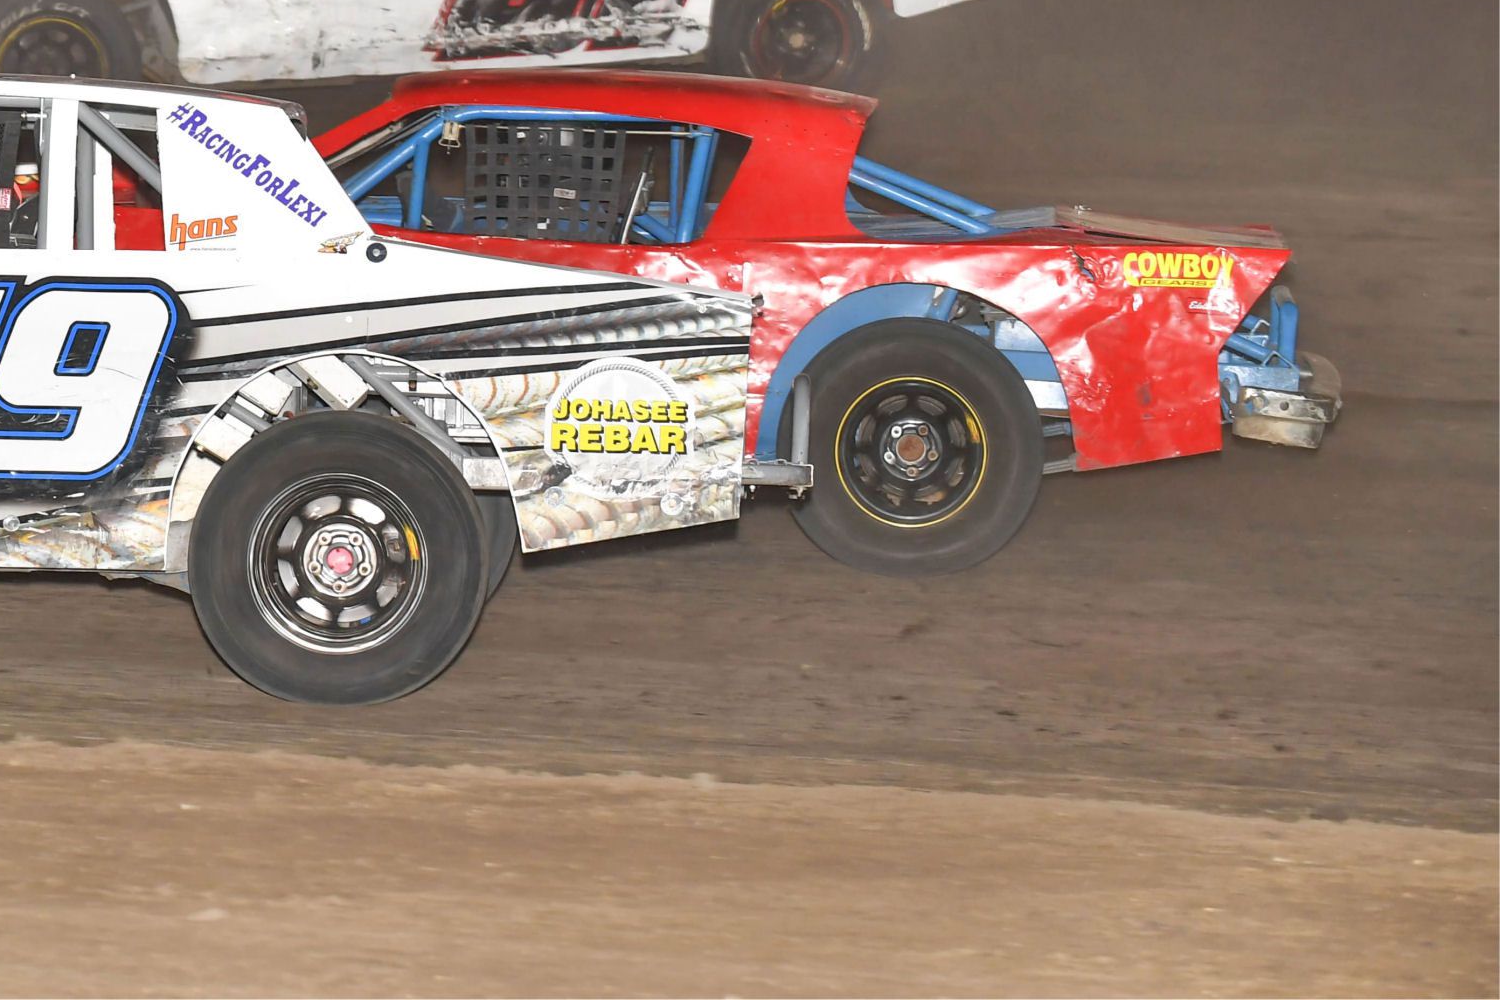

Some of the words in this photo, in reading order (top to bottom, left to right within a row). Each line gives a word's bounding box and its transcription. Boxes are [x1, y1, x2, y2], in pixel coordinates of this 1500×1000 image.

[170, 213, 238, 251] hans
[1123, 252, 1234, 288] COWBOY
[552, 398, 688, 423] JOHASEE
[551, 424, 687, 454] REBAR
